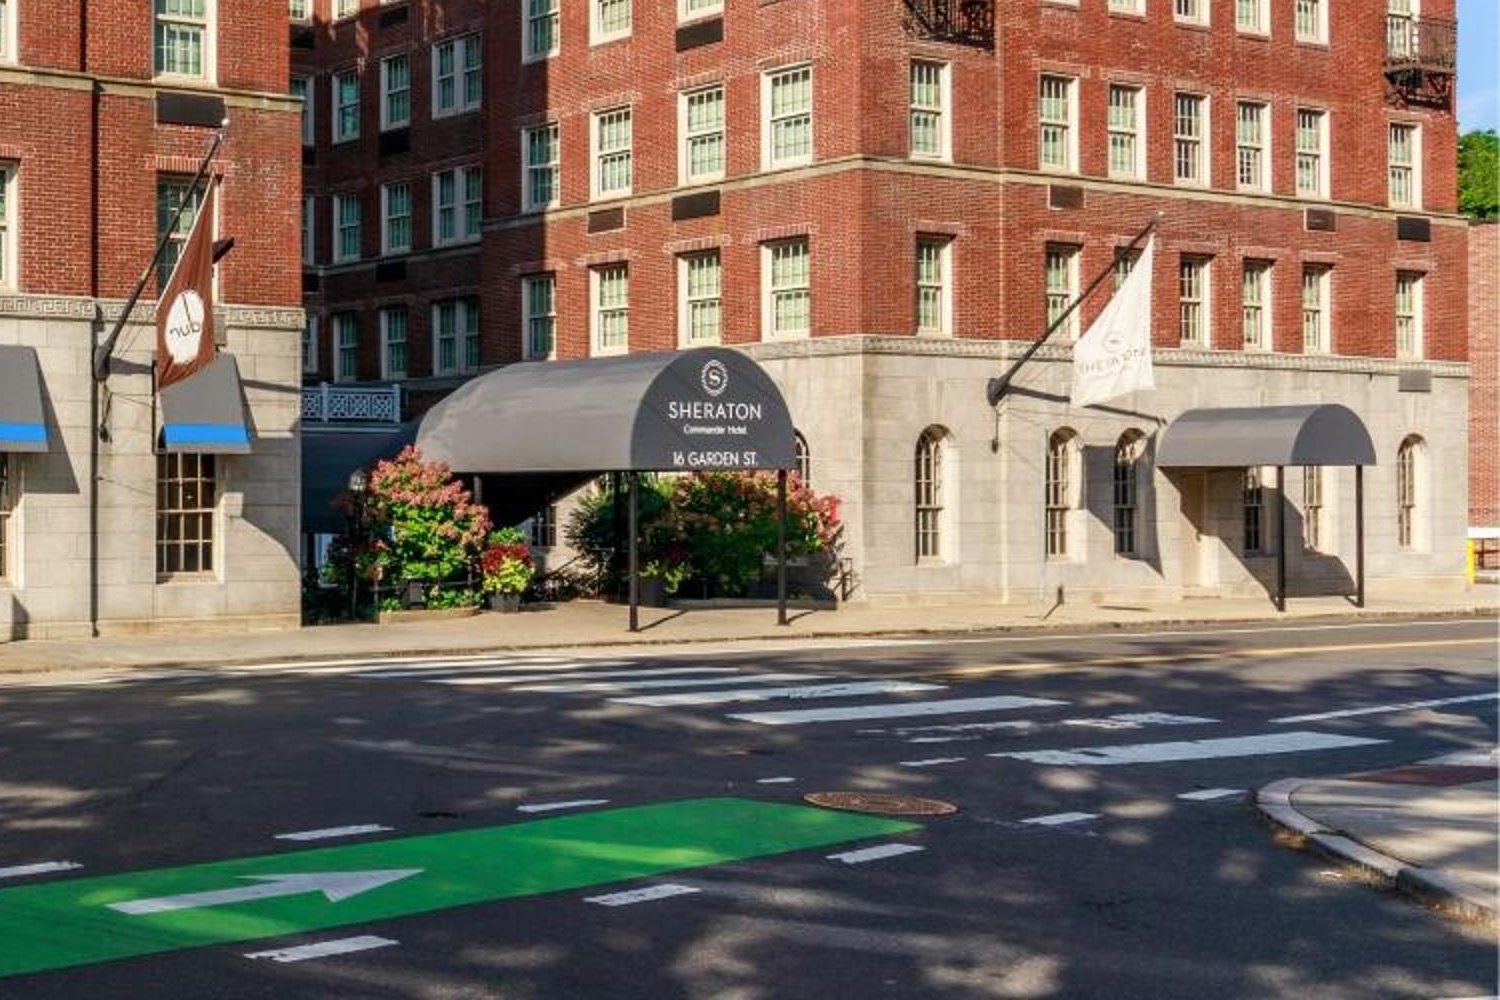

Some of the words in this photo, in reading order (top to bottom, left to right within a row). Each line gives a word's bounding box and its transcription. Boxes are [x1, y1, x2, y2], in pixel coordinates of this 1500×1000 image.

[668, 401, 762, 420] SHERATON
[673, 451, 685, 466] 16
[687, 451, 739, 466] GARDEN
